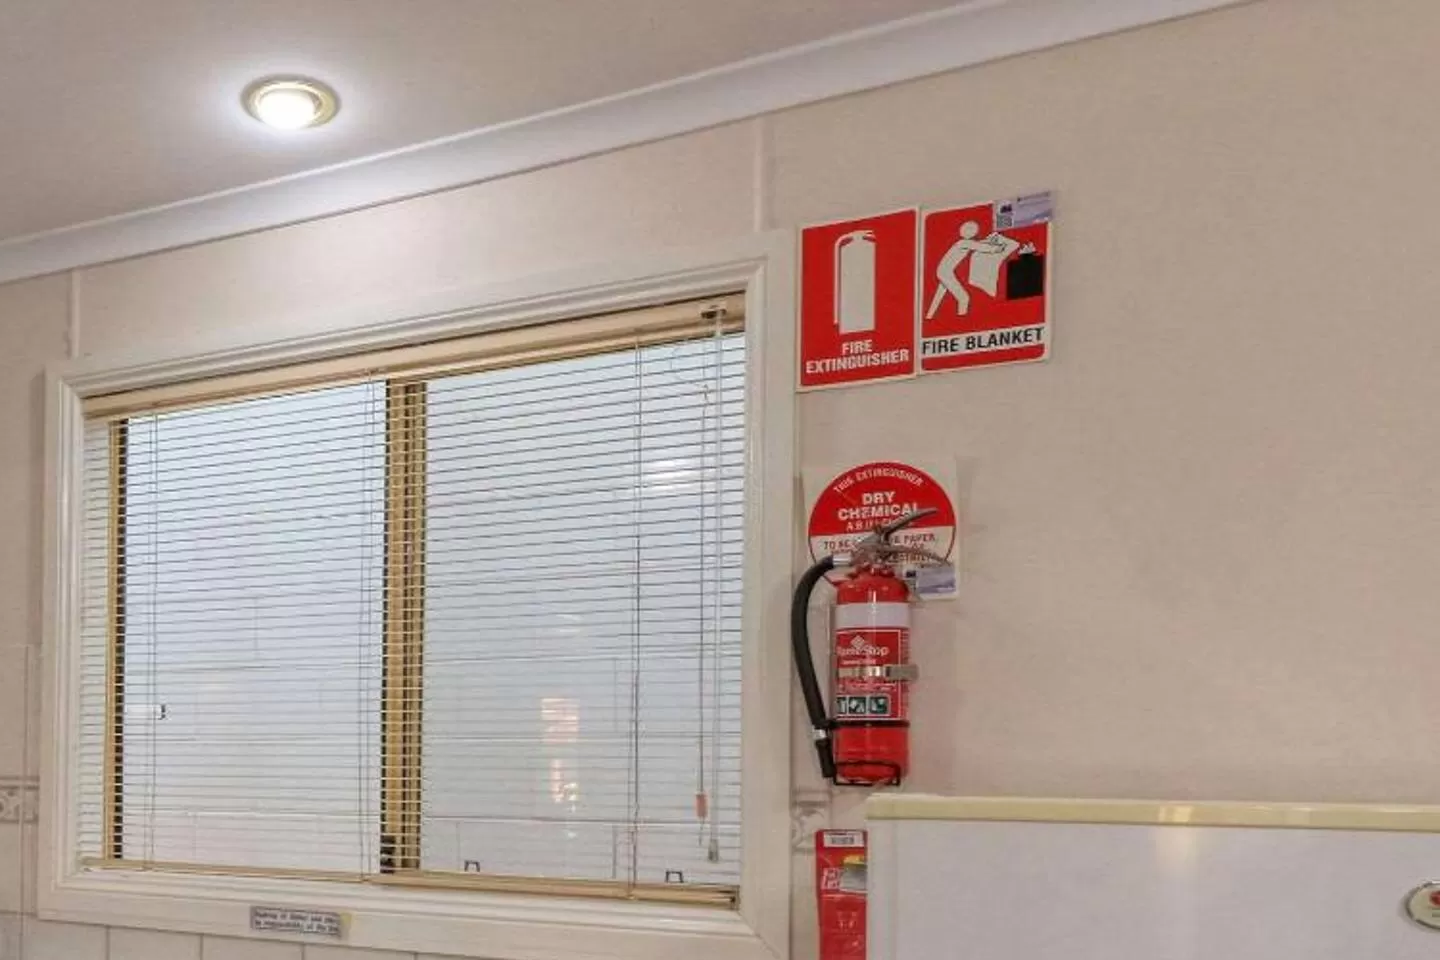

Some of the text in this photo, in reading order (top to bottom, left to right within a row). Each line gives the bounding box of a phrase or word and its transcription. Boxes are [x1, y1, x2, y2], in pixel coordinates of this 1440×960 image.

[842, 339, 872, 355] FIRE
[922, 327, 1045, 355] FIRE BLANKET
[806, 349, 910, 373] EXTINGUISHER
[862, 491, 895, 505] DRY
